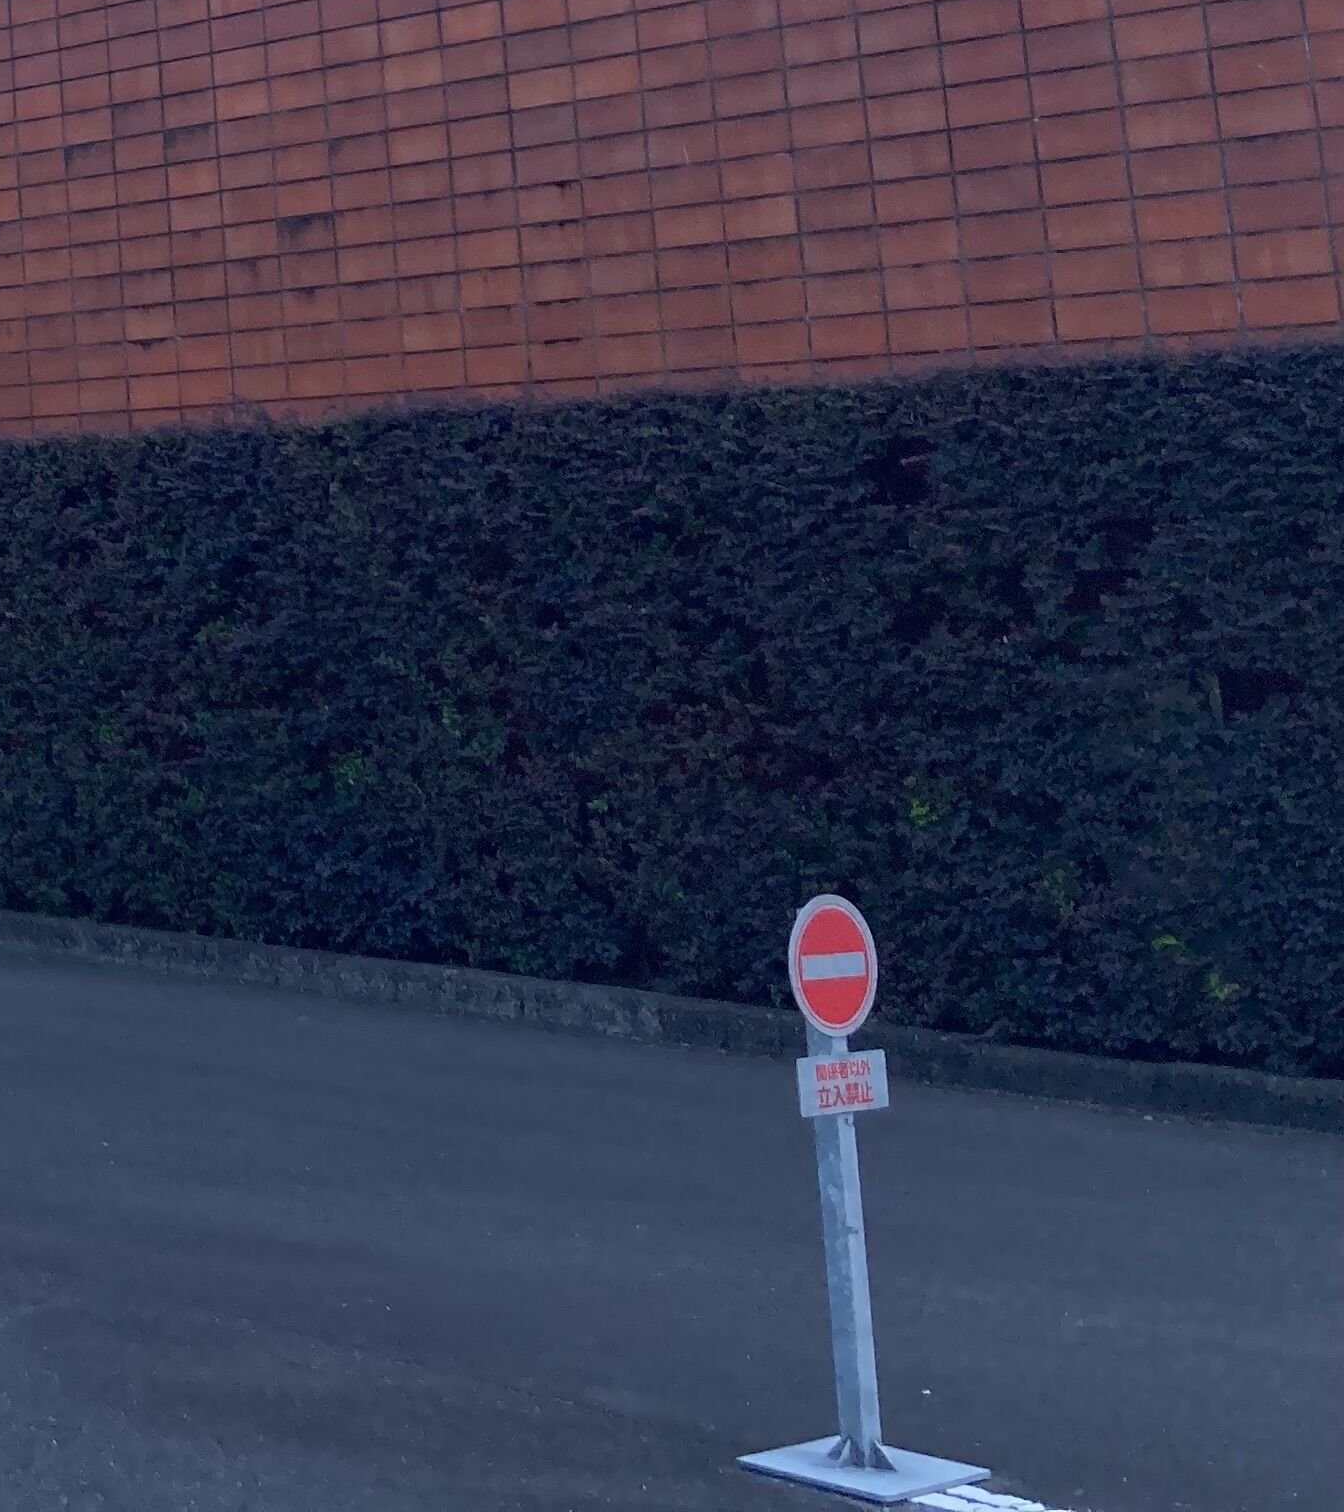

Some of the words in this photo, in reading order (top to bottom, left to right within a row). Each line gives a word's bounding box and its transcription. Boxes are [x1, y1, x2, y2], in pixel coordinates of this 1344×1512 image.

[815, 1058, 871, 1082] 関係者以外
[817, 1081, 874, 1109] 立入禁止
